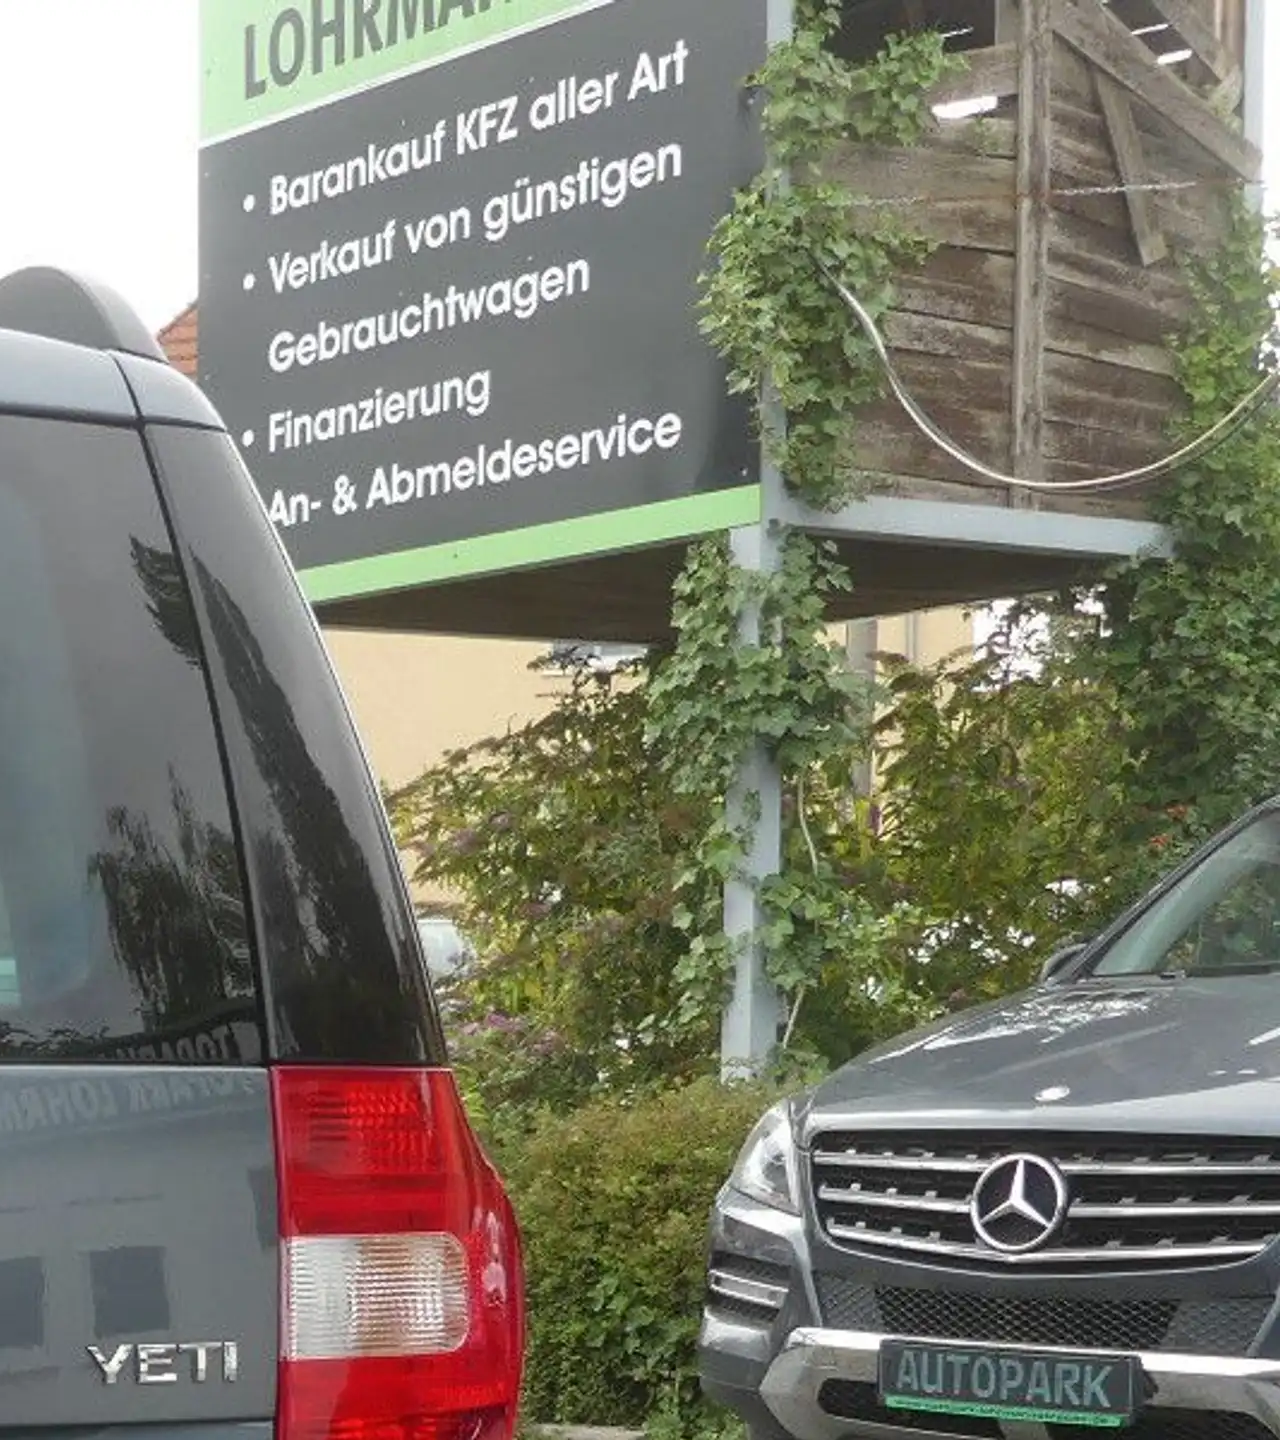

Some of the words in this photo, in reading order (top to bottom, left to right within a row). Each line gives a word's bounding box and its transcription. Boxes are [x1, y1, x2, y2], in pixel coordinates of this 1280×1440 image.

[244, 0, 511, 99] LOHRM
[269, 120, 446, 215] Barankauf
[456, 97, 518, 156] KFZ
[529, 68, 620, 132] aller
[627, 40, 689, 102] Art
[268, 220, 398, 294] Verkauf
[405, 206, 471, 255] von
[483, 143, 682, 241] günstigen
[268, 258, 590, 372] Gebrauchtwagen
[268, 369, 491, 453] Finanzierung
[269, 488, 322, 527] An-
[332, 474, 357, 516] &
[366, 411, 682, 510] Abmeldeservice
[86, 1341, 239, 1385] YETI
[896, 1349, 1113, 1408] AUTOPARK
